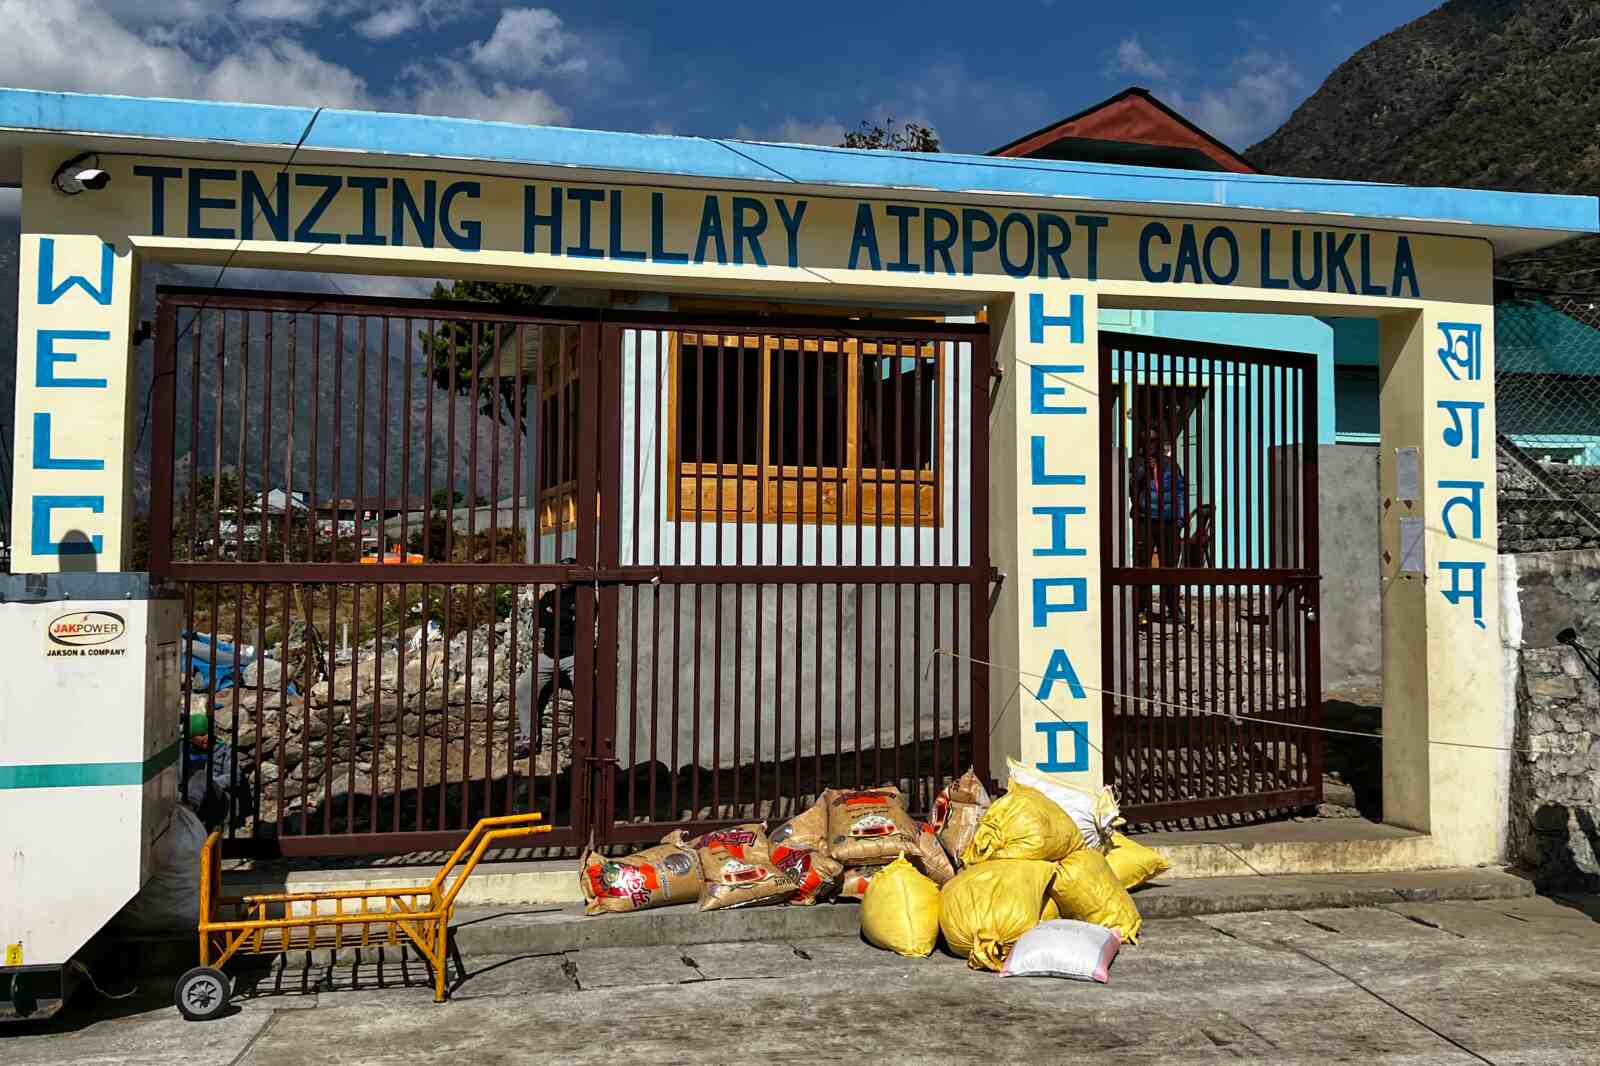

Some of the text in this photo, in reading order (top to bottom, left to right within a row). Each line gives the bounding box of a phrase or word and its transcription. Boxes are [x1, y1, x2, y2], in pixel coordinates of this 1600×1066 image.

[133, 164, 1420, 297] TENZING HILLARY AIRPORT CAO LUKLA
[1028, 293, 1090, 773] HELIPAD
[47, 648, 126, 656] JAKSON & COMPANY
[53, 623, 119, 633] JAKPOWER
